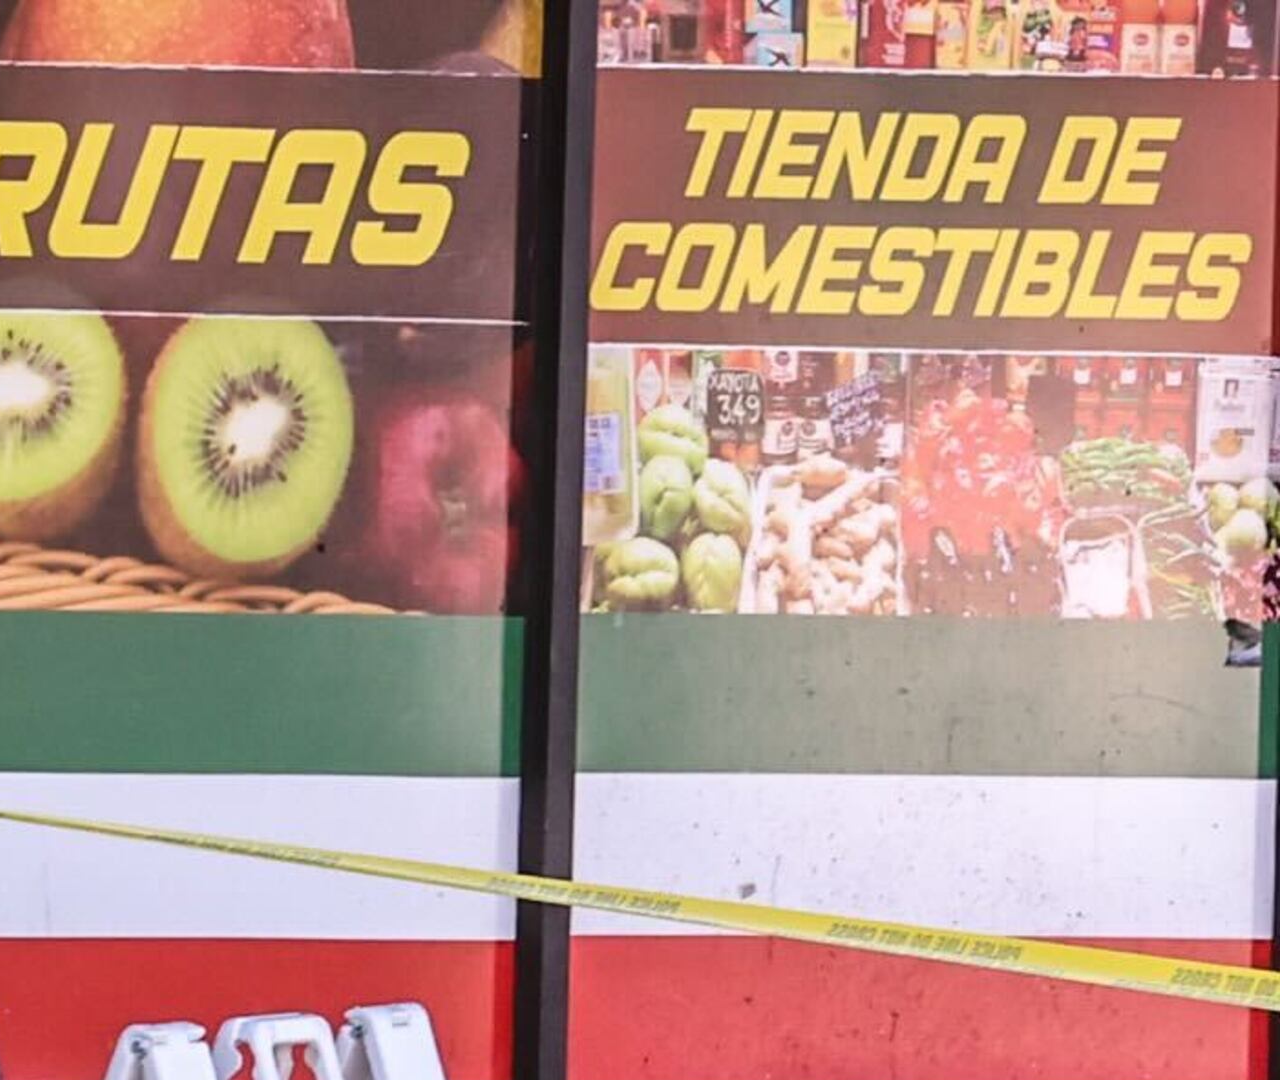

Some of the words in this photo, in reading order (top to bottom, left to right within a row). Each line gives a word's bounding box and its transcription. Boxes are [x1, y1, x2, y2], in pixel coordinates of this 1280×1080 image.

[683, 107, 1028, 204] TIENDA
[1037, 115, 1183, 206] DE
[588, 221, 1253, 323] COMESTIBLES
